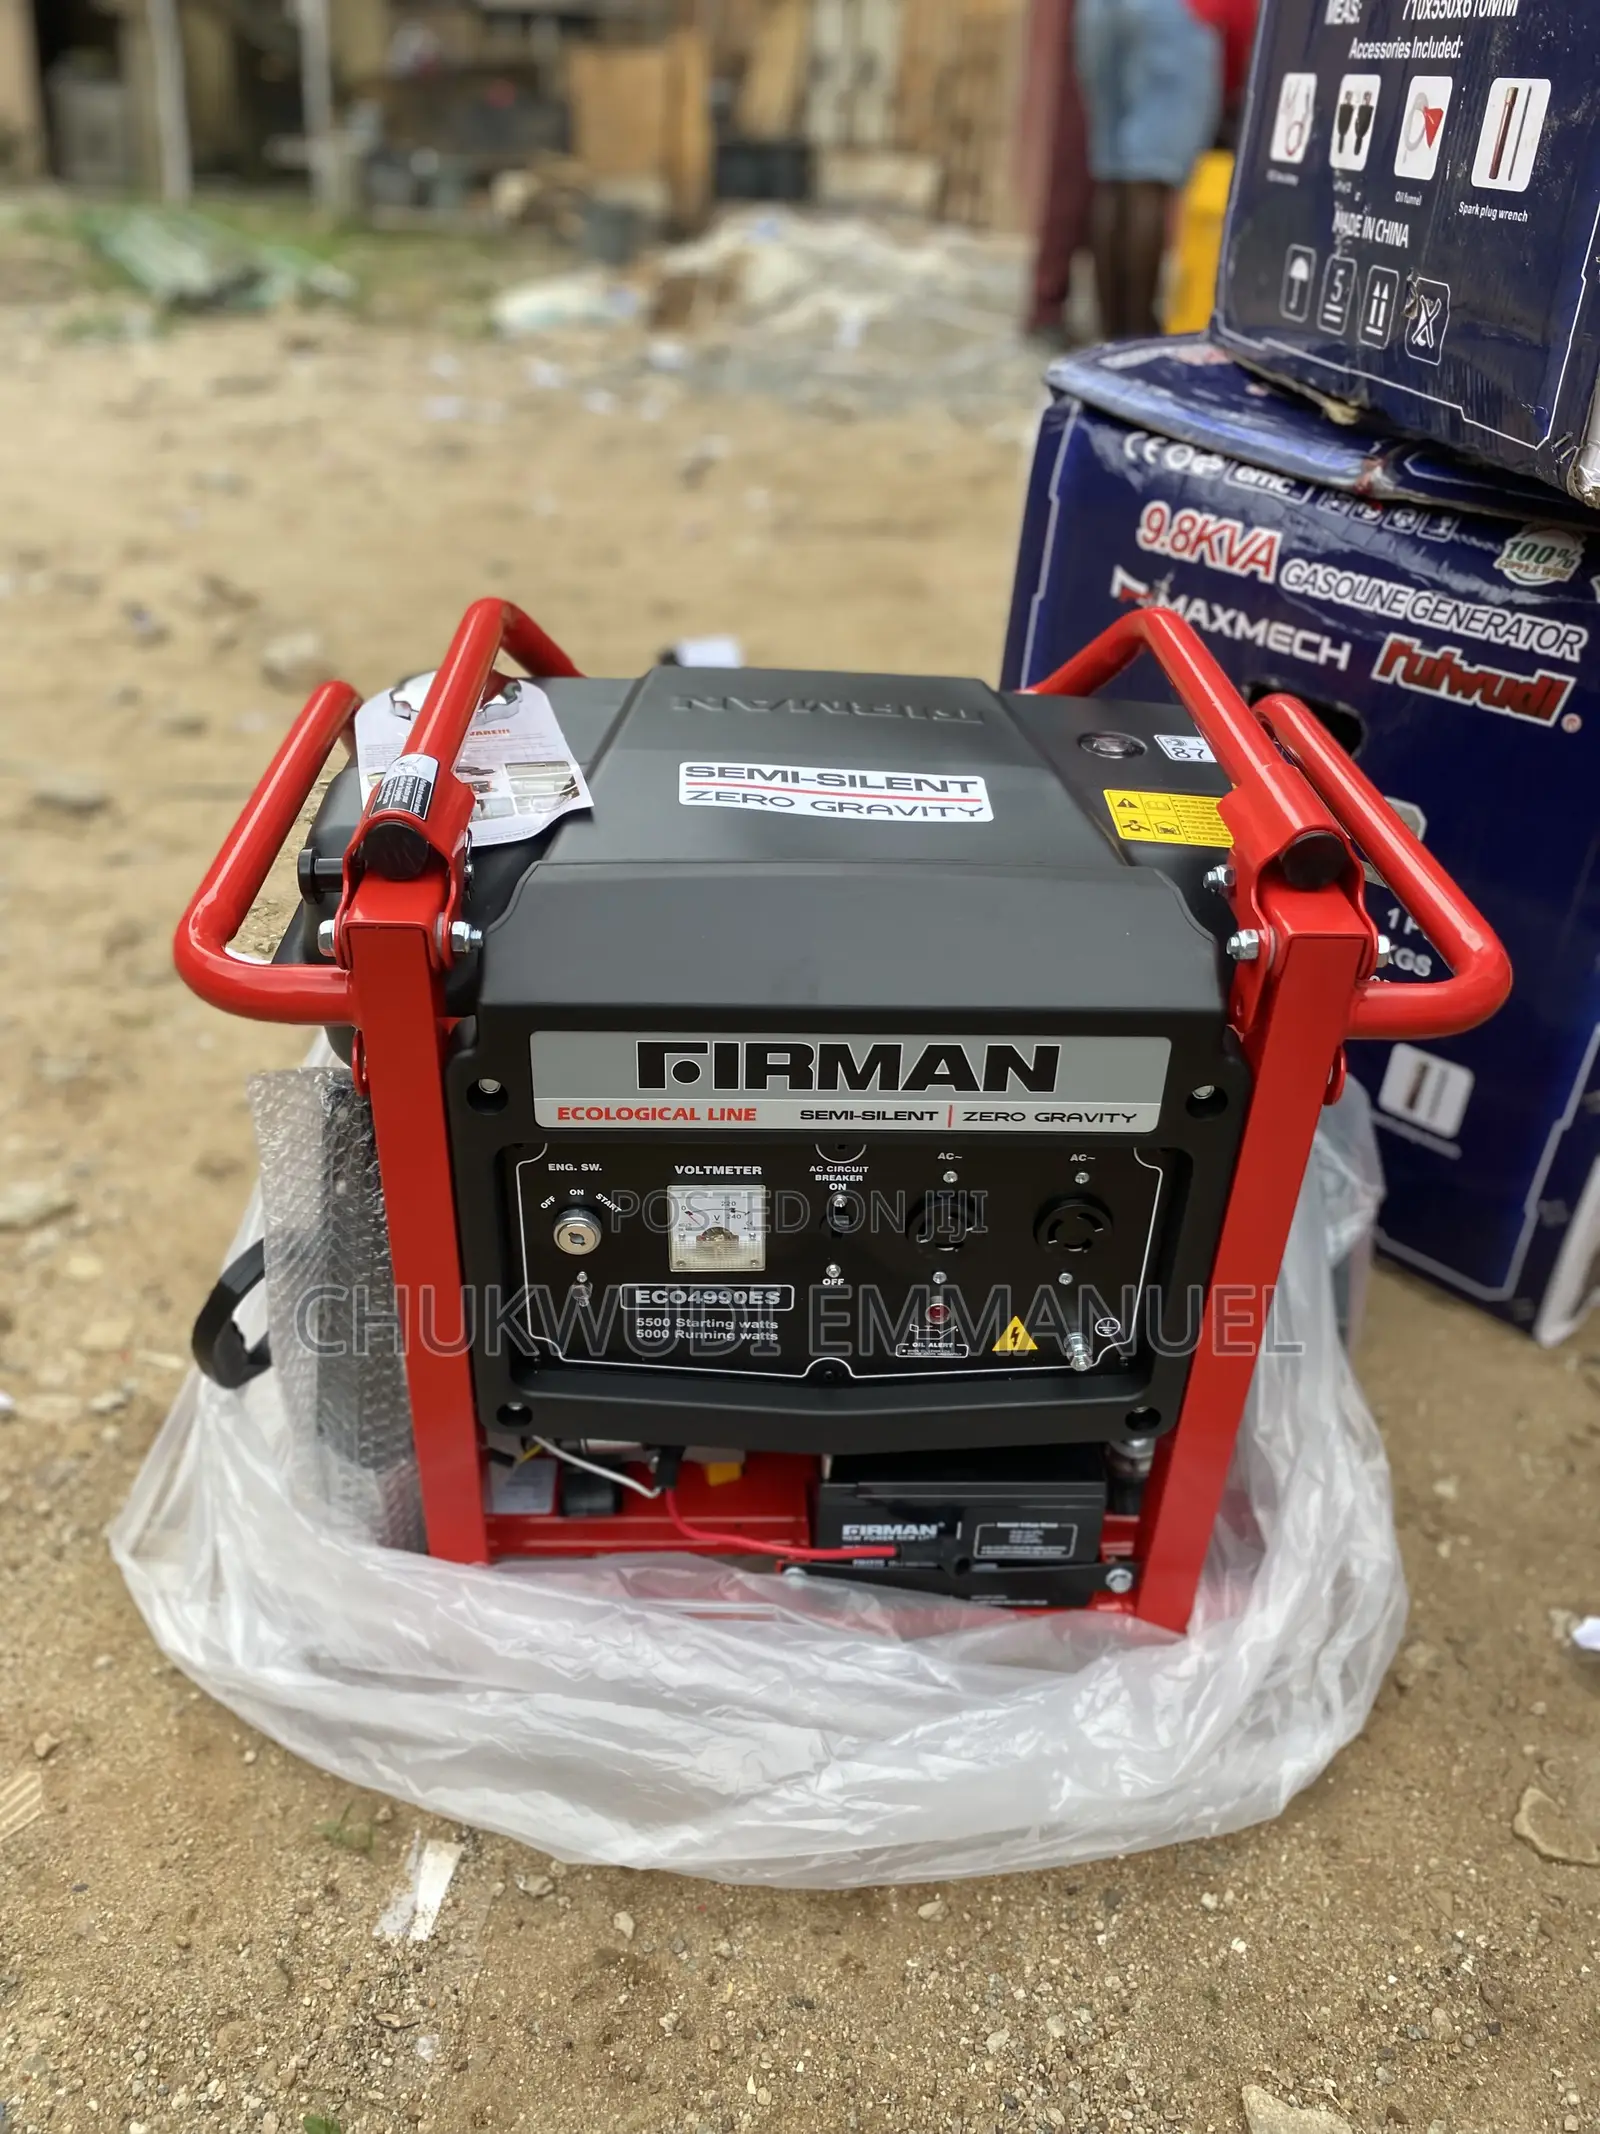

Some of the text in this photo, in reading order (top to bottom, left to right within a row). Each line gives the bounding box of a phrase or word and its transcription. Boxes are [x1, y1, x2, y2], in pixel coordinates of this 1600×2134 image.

[1349, 35, 1463, 59] Accessories Included:
[1458, 200, 1528, 223] Spark plug wrench
[1375, 219, 1409, 249] CHINA
[1136, 499, 1283, 584] 9.8KVA
[1507, 541, 1578, 569] 100%
[1280, 558, 1589, 663] GASOLINE GENERATOR
[1155, 594, 1352, 672] MAXMECH
[685, 765, 978, 794] SEMI-SILENT
[686, 790, 985, 817] ZERO GRAVITY
[636, 1040, 1062, 1093] FIRMAN
[557, 1106, 757, 1121] ECOLOGICAL LINE
[799, 1109, 939, 1122] SEMI-SILENT
[962, 1110, 1138, 1124] ZERO GRAVITY
[547, 1163, 603, 1172] ENG. SW.
[674, 1165, 763, 1175] VOLTMETER
[809, 1165, 869, 1173] AC CIRCUIT
[814, 1174, 864, 1182] BREAKER
[569, 1188, 585, 1196] ON
[828, 1183, 847, 1191] ON
[540, 1195, 557, 1210] OFF
[595, 1192, 623, 1214] START
[821, 1278, 845, 1286] OFF
[635, 1289, 781, 1305] ECO4990ES
[636, 1317, 779, 1330] 5500 Starting watts
[636, 1329, 779, 1342] 5000 Running watts
[842, 1524, 938, 1535] FIRMAN
